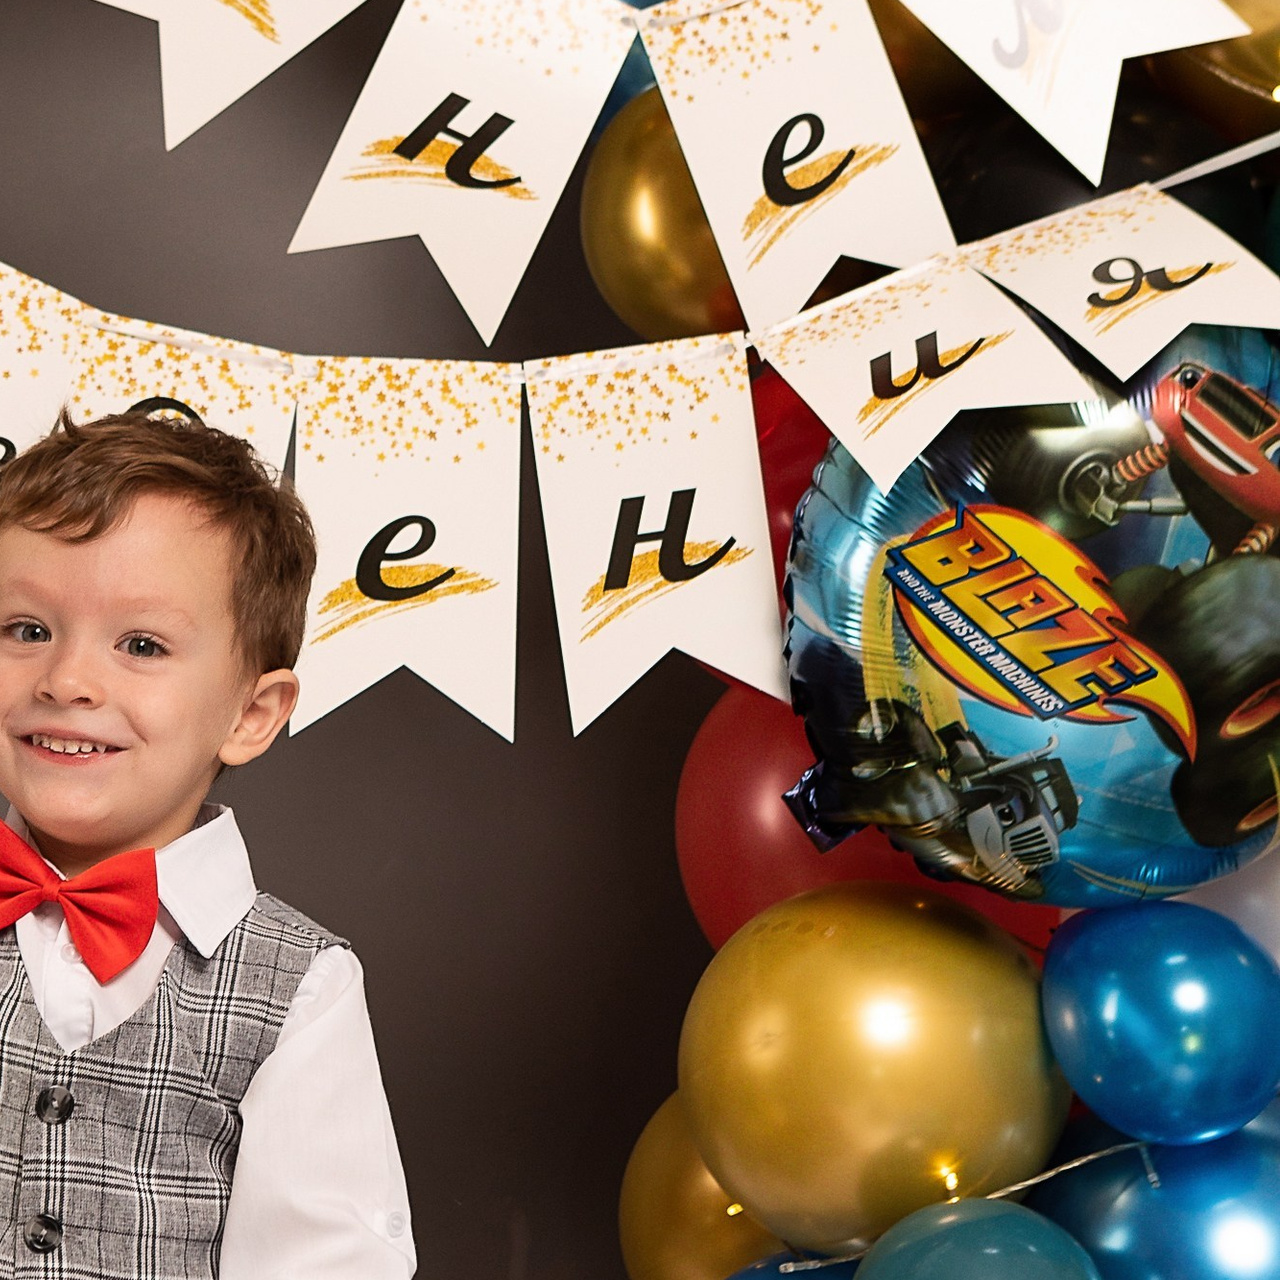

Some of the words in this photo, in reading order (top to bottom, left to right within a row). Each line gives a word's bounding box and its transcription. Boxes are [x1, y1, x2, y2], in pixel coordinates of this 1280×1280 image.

[896, 568, 921, 589] AND
[913, 584, 936, 602] THE
[927, 599, 996, 656] MONSTER
[985, 651, 1064, 712] MACHINES
[898, 506, 1154, 704] BLAZE
